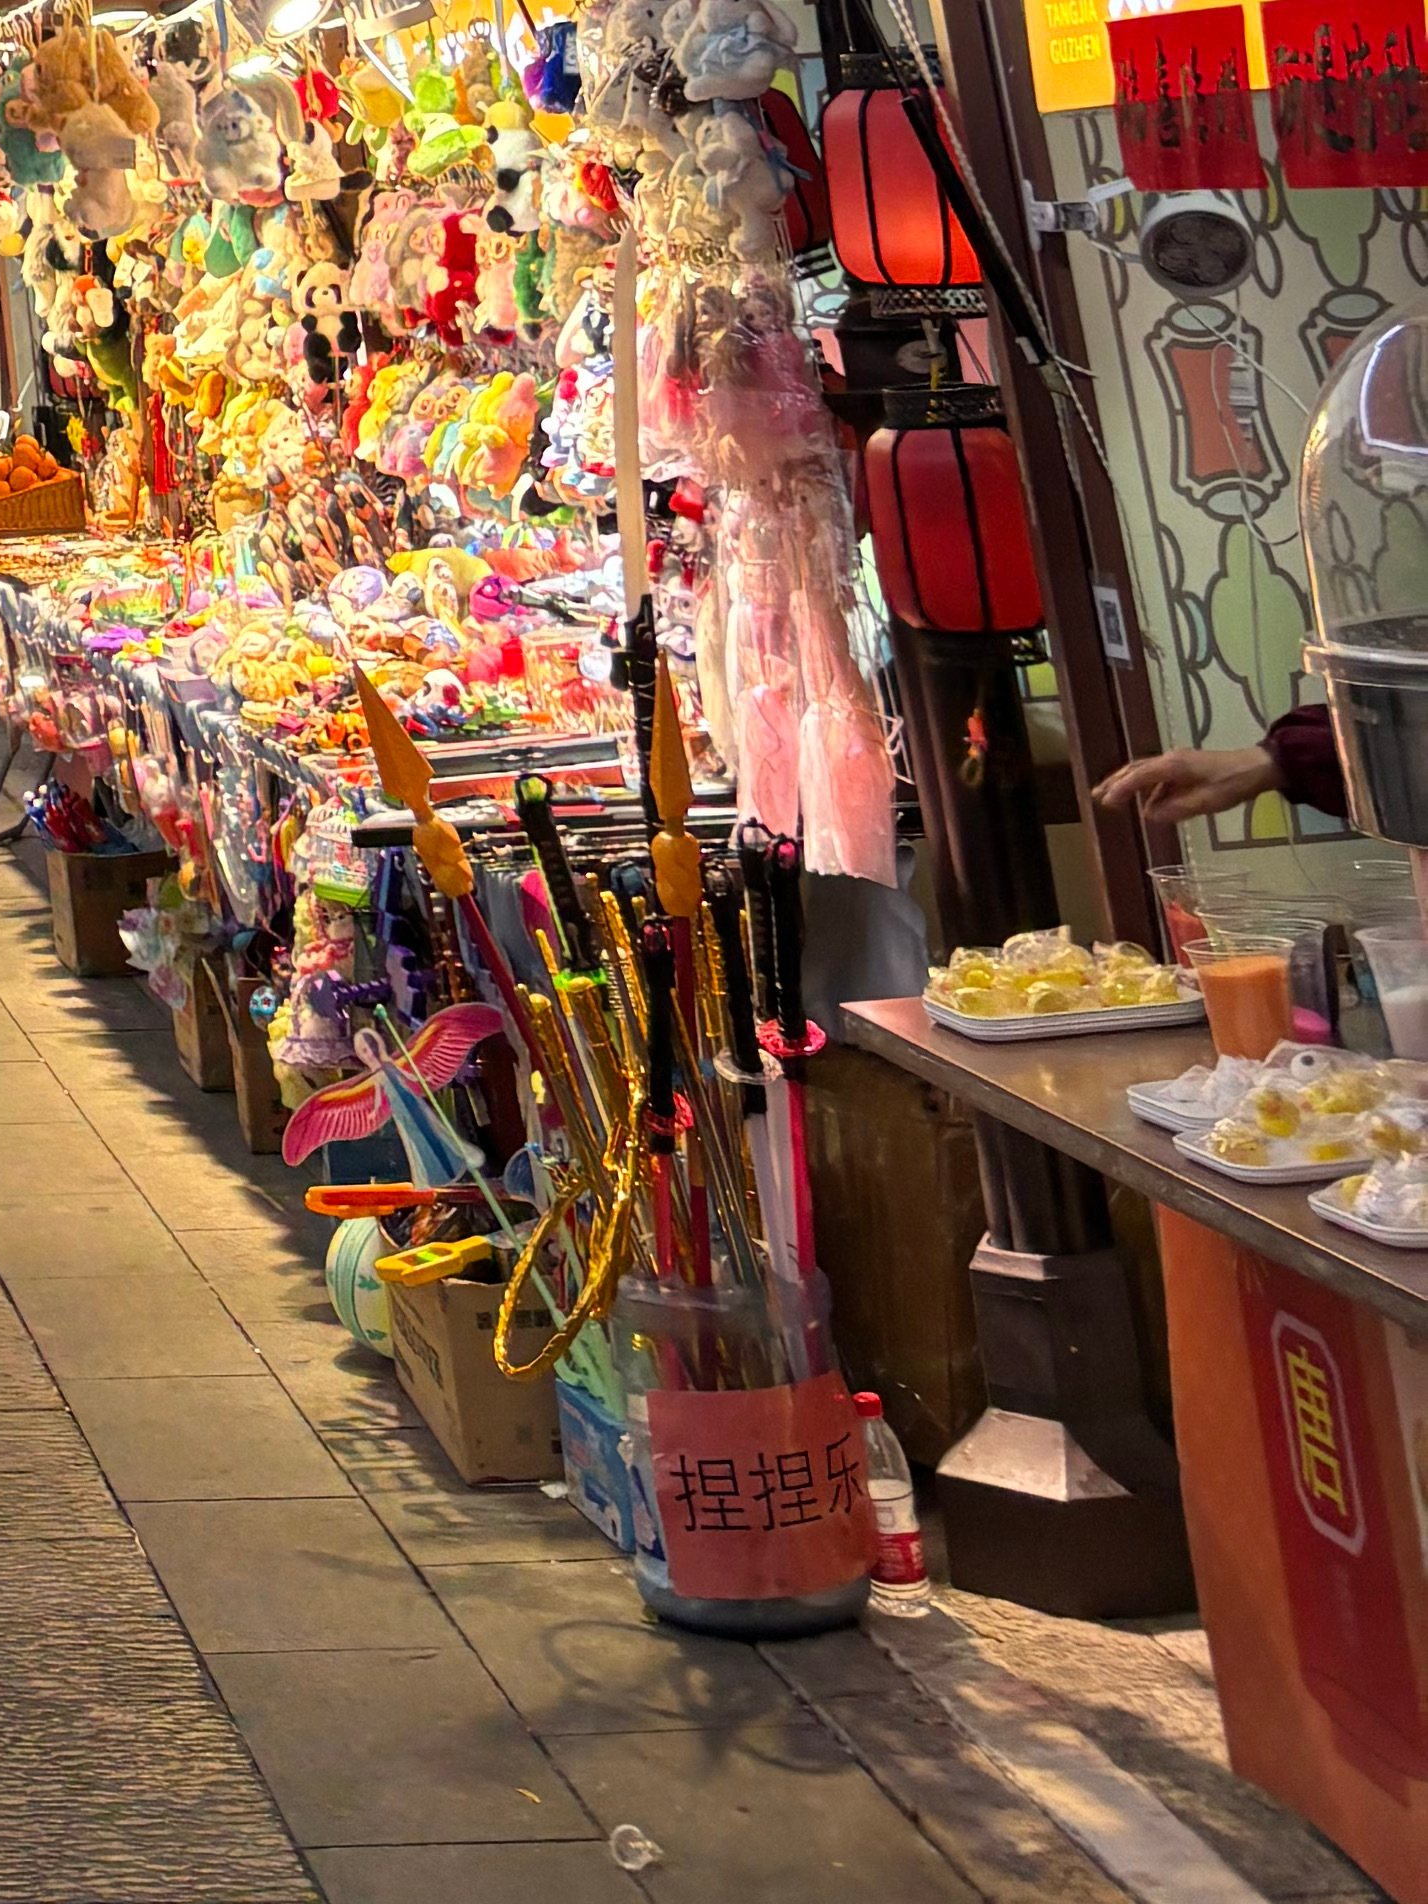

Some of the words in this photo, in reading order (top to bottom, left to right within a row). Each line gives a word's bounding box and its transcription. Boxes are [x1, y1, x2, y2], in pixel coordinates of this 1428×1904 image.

[1049, 33, 1102, 65] GUZHEN
[669, 1432, 864, 1532] 捏捏乐
